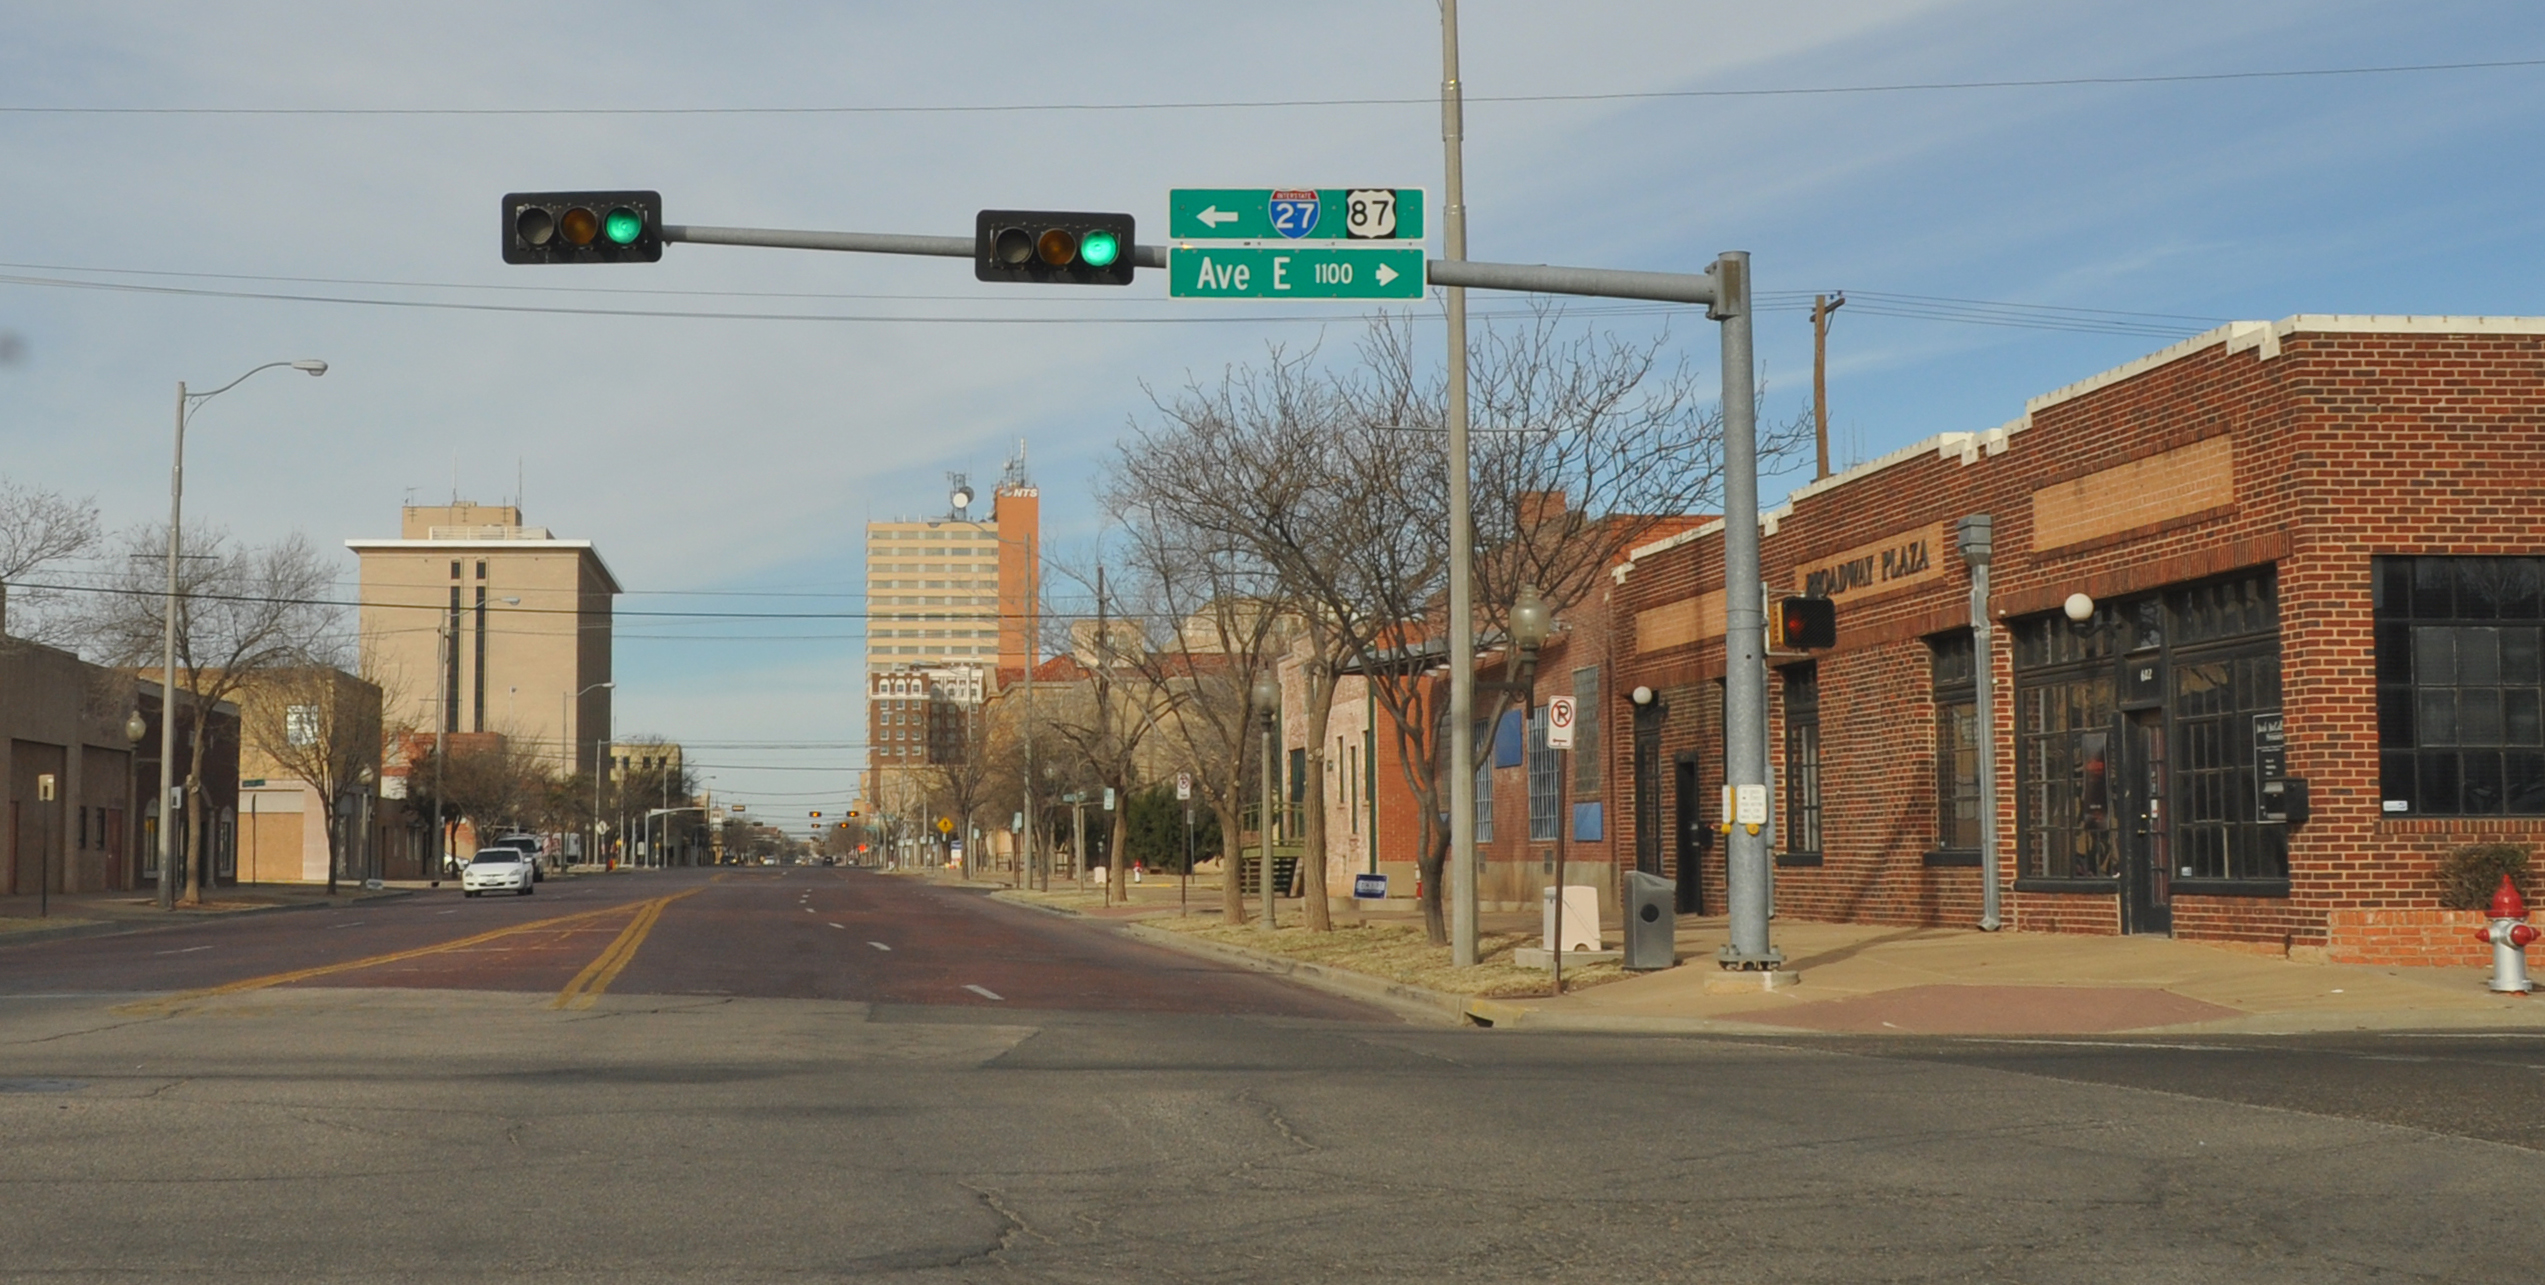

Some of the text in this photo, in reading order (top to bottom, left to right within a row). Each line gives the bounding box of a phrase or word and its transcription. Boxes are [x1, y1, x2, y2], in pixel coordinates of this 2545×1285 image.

[1276, 191, 1312, 200] INTERSTATE
[1276, 203, 1315, 228] 27
[1351, 200, 1389, 226] 87
[1197, 256, 1353, 290] Ave E 1100
[1013, 488, 1038, 498] NTS
[1806, 539, 1930, 598] BROADWAY PLAZA
